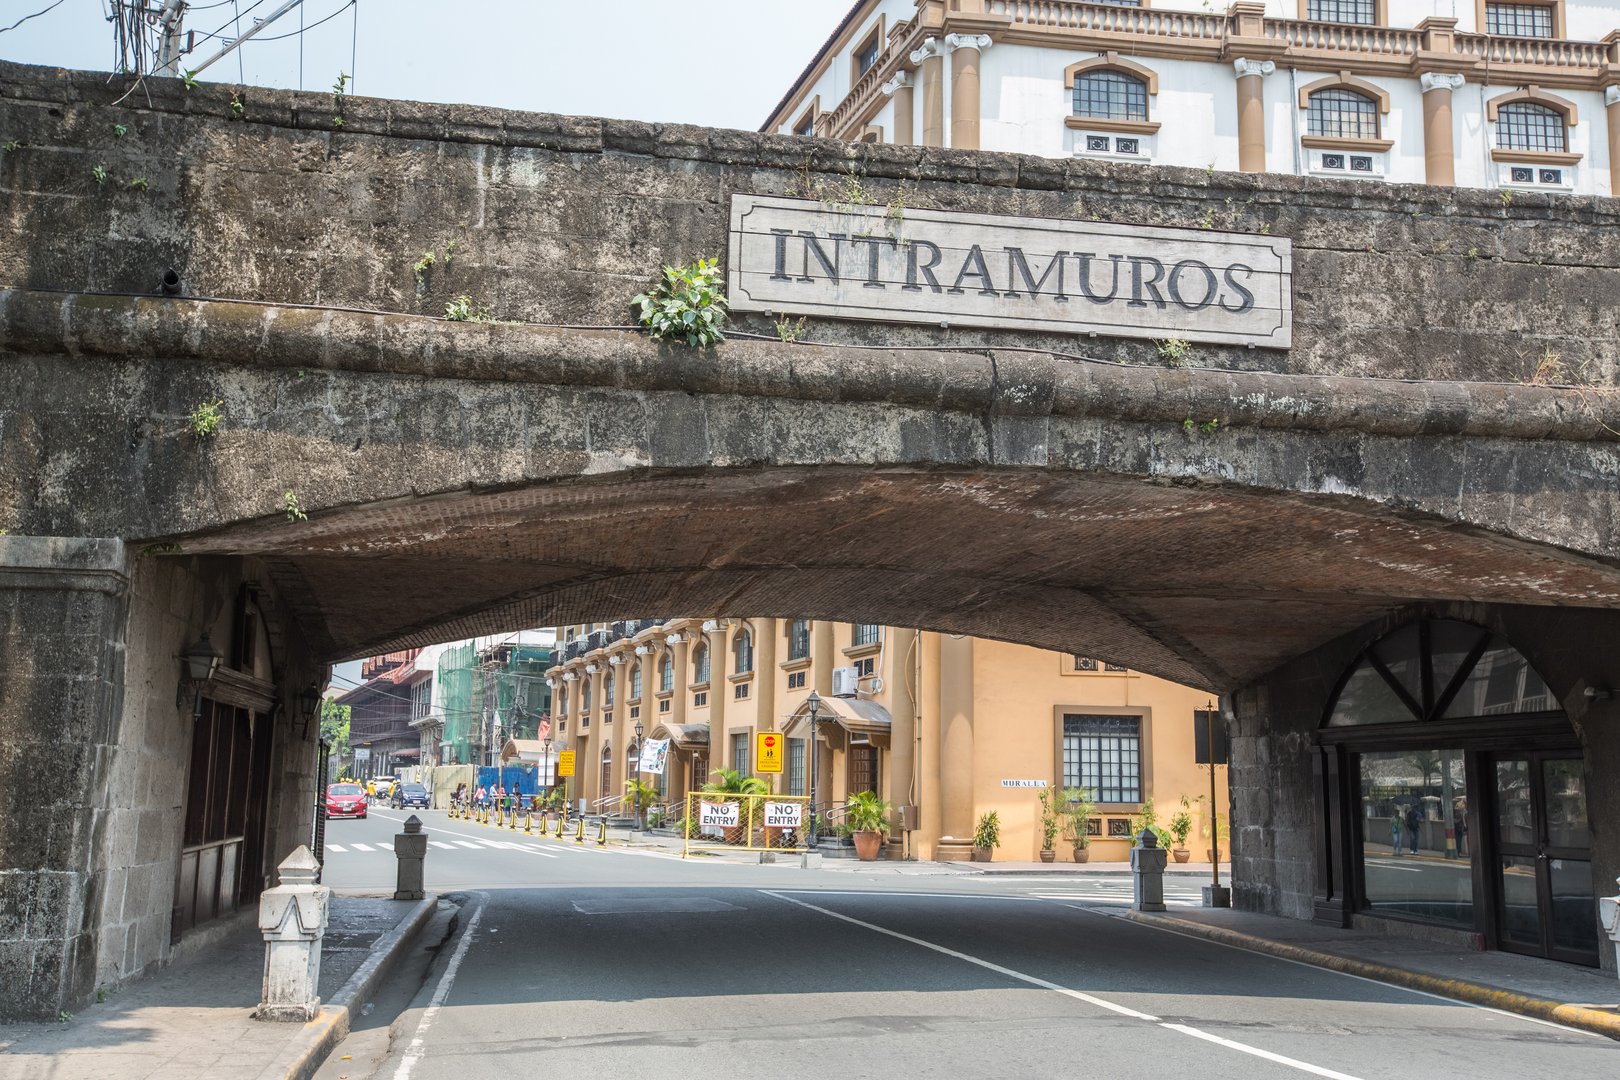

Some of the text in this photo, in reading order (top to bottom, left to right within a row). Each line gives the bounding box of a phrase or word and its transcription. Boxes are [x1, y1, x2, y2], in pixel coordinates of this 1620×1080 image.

[769, 228, 1255, 314] INTRAMUROS
[710, 805, 729, 815] NO
[774, 805, 793, 815] NO
[703, 815, 736, 825] ENTRY
[768, 816, 799, 825] ENTRY
